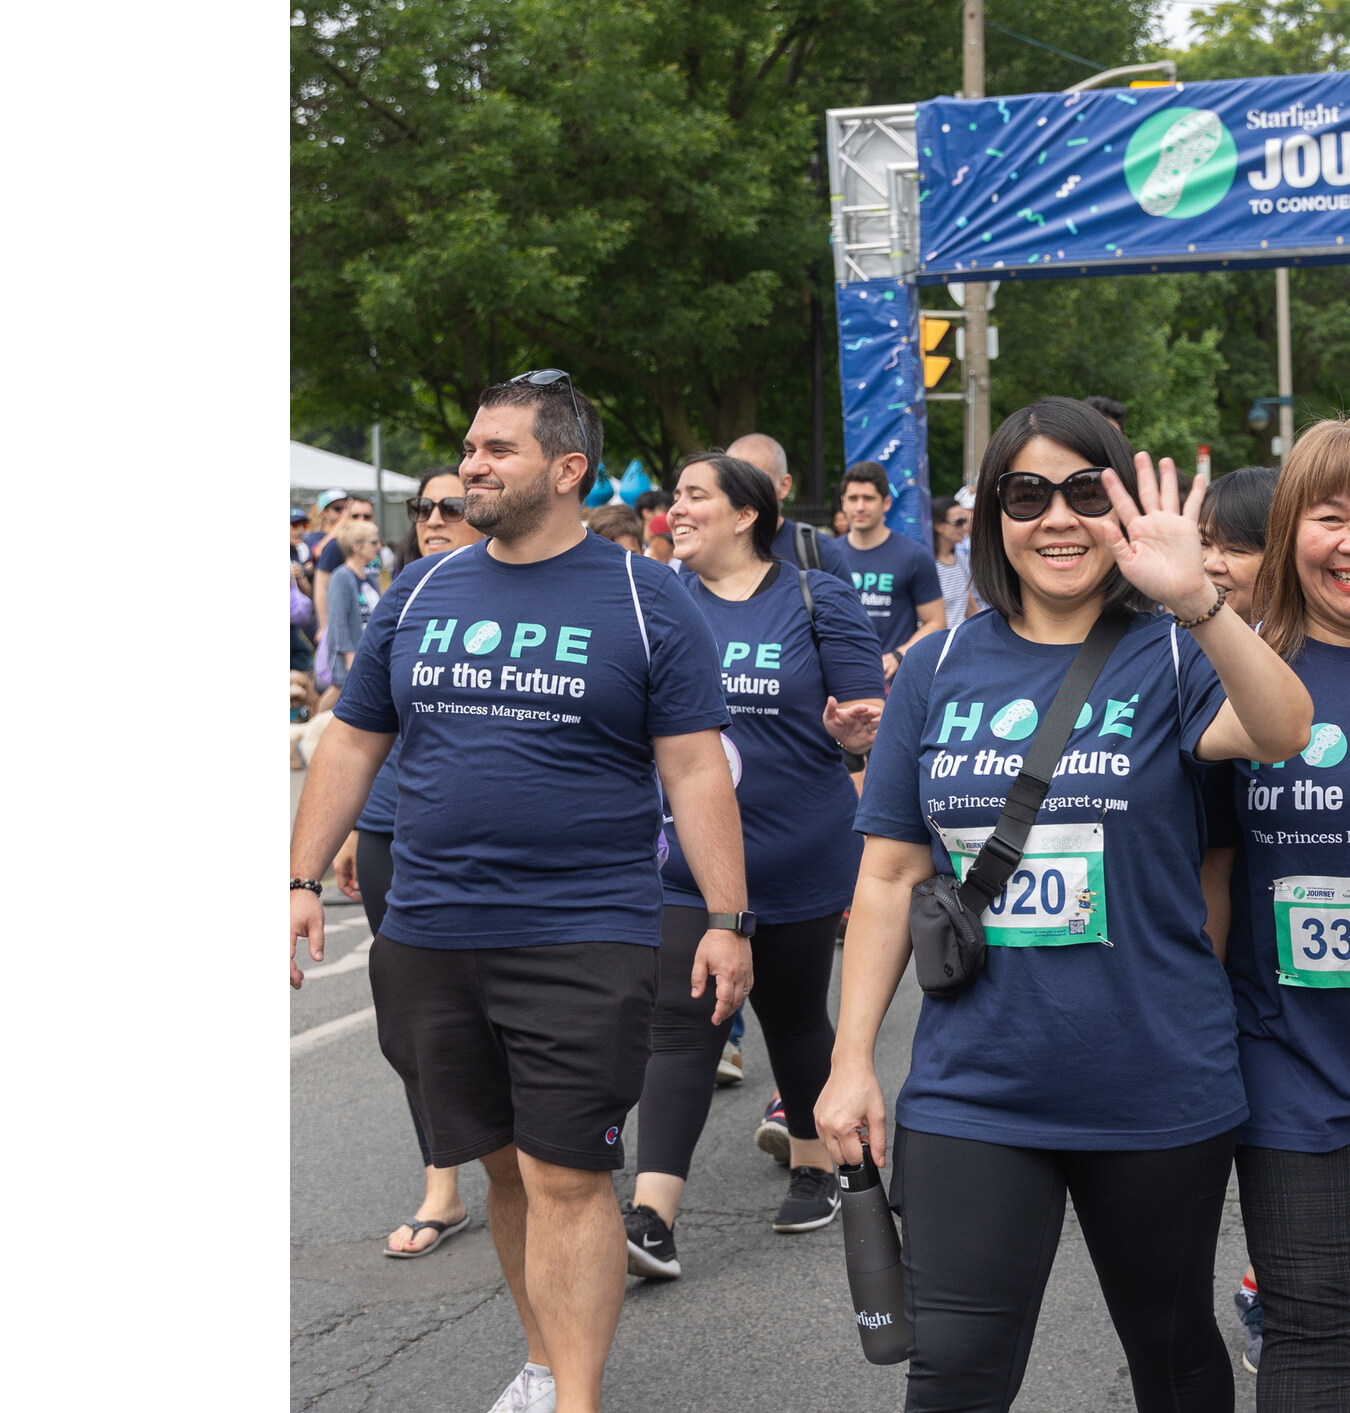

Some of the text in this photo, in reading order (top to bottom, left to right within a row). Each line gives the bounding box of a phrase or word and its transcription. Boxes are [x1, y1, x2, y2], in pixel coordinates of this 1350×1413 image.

[1246, 102, 1341, 131] Starlight
[1248, 199, 1274, 215] TO
[418, 619, 592, 664] HOPE
[412, 661, 586, 698] for the Future
[412, 702, 581, 724] The Princess Margaret UHN
[931, 749, 1130, 779] for the uture
[928, 794, 1128, 813] The Princes rgaret UHN
[1248, 778, 1285, 811] for
[1292, 779, 1344, 811] the
[1041, 835, 1083, 850] 2024
[1252, 830, 1274, 844] The
[1277, 831, 1343, 844] Princess
[988, 868, 1066, 915] 020
[1306, 890, 1335, 898] JOURNEY
